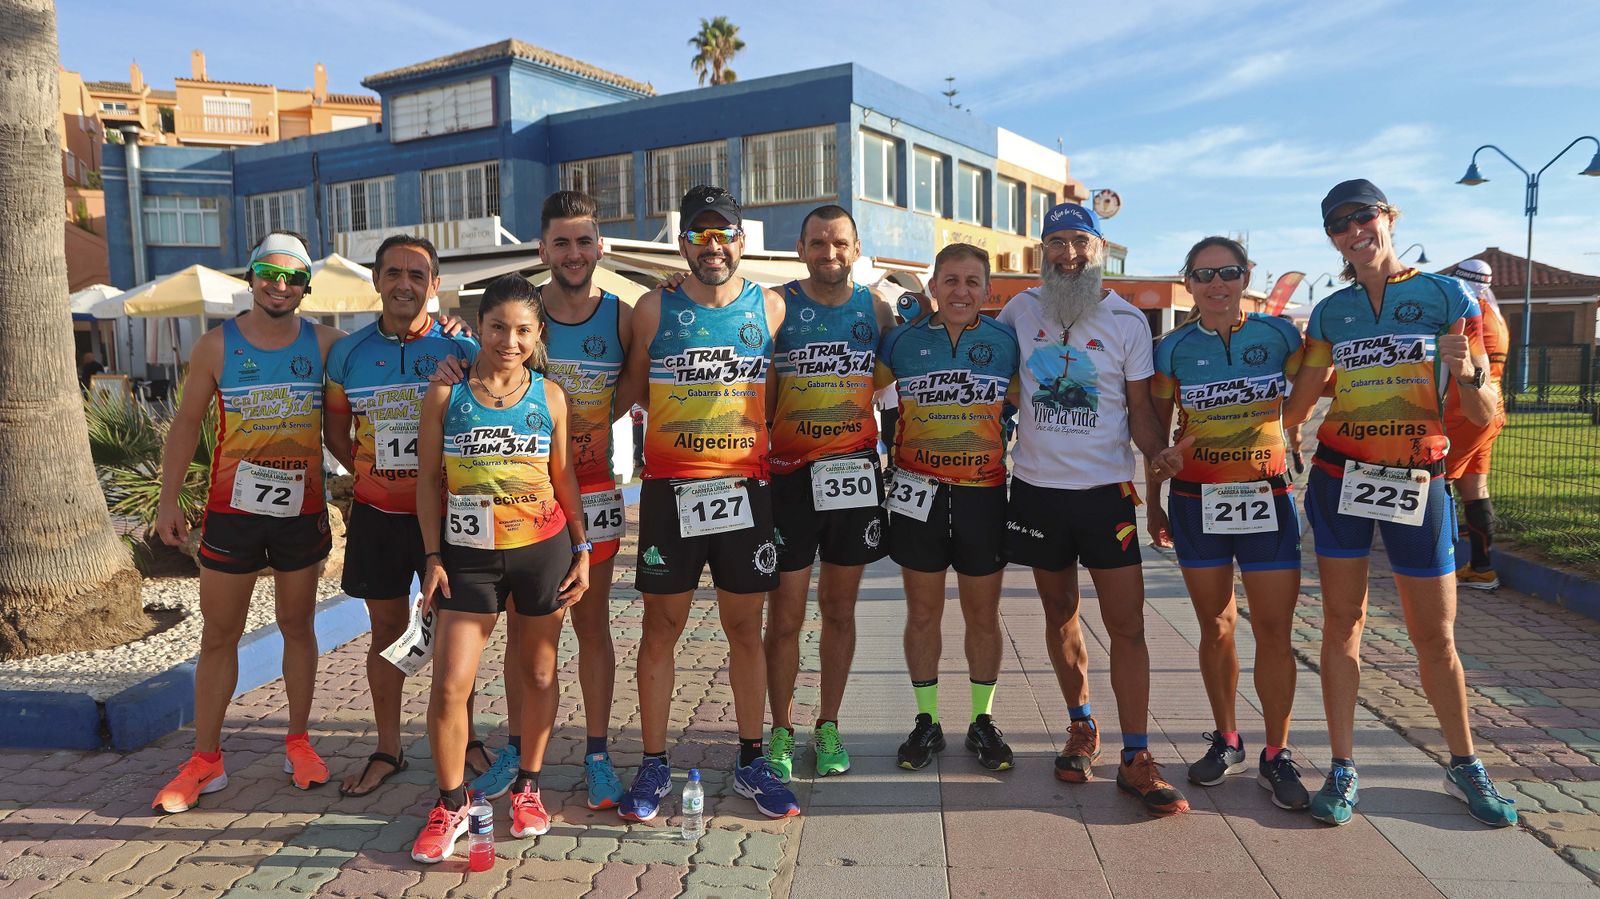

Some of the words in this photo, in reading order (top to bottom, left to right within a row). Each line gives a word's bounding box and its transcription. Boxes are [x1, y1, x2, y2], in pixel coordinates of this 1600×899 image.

[808, 344, 847, 359] TRAIL
[1351, 337, 1392, 353] TRAIL
[687, 349, 733, 366] TRAIL
[1344, 352, 1382, 368] TEAM
[548, 364, 577, 374] RAIL
[677, 367, 722, 382] TEAM
[798, 361, 838, 374] TEAM
[928, 372, 970, 388] TRAIL
[1206, 380, 1248, 396] TRAIL
[1351, 379, 1384, 388] Gabarras
[1396, 376, 1430, 384] Servicios
[251, 388, 289, 404] TRAIL
[377, 388, 418, 406] TRAIL
[688, 389, 721, 397] Gabarras
[917, 390, 959, 403] TEAM
[243, 404, 280, 417] TEAM
[1196, 396, 1238, 409] TEAM
[367, 406, 408, 420] TEAM
[1034, 402, 1054, 423] Vive
[1056, 406, 1067, 425] la
[1071, 408, 1097, 428] vida
[473, 428, 511, 441] TRAIL
[796, 420, 862, 439] Algeciras
[1337, 420, 1426, 440] Algeciras
[462, 443, 502, 455] TEAM
[674, 433, 755, 452] Algeciras
[915, 449, 990, 468] Algeciras
[1193, 448, 1271, 464] Algeciras
[370, 464, 418, 480] Algec
[255, 483, 291, 506] 72
[825, 476, 872, 497] 350
[889, 481, 927, 508] 231
[493, 493, 537, 505] eciras
[1354, 483, 1420, 511] 225
[692, 496, 744, 522] 127
[1215, 501, 1270, 521] 212
[450, 513, 480, 536] 53
[584, 508, 622, 530] 145
